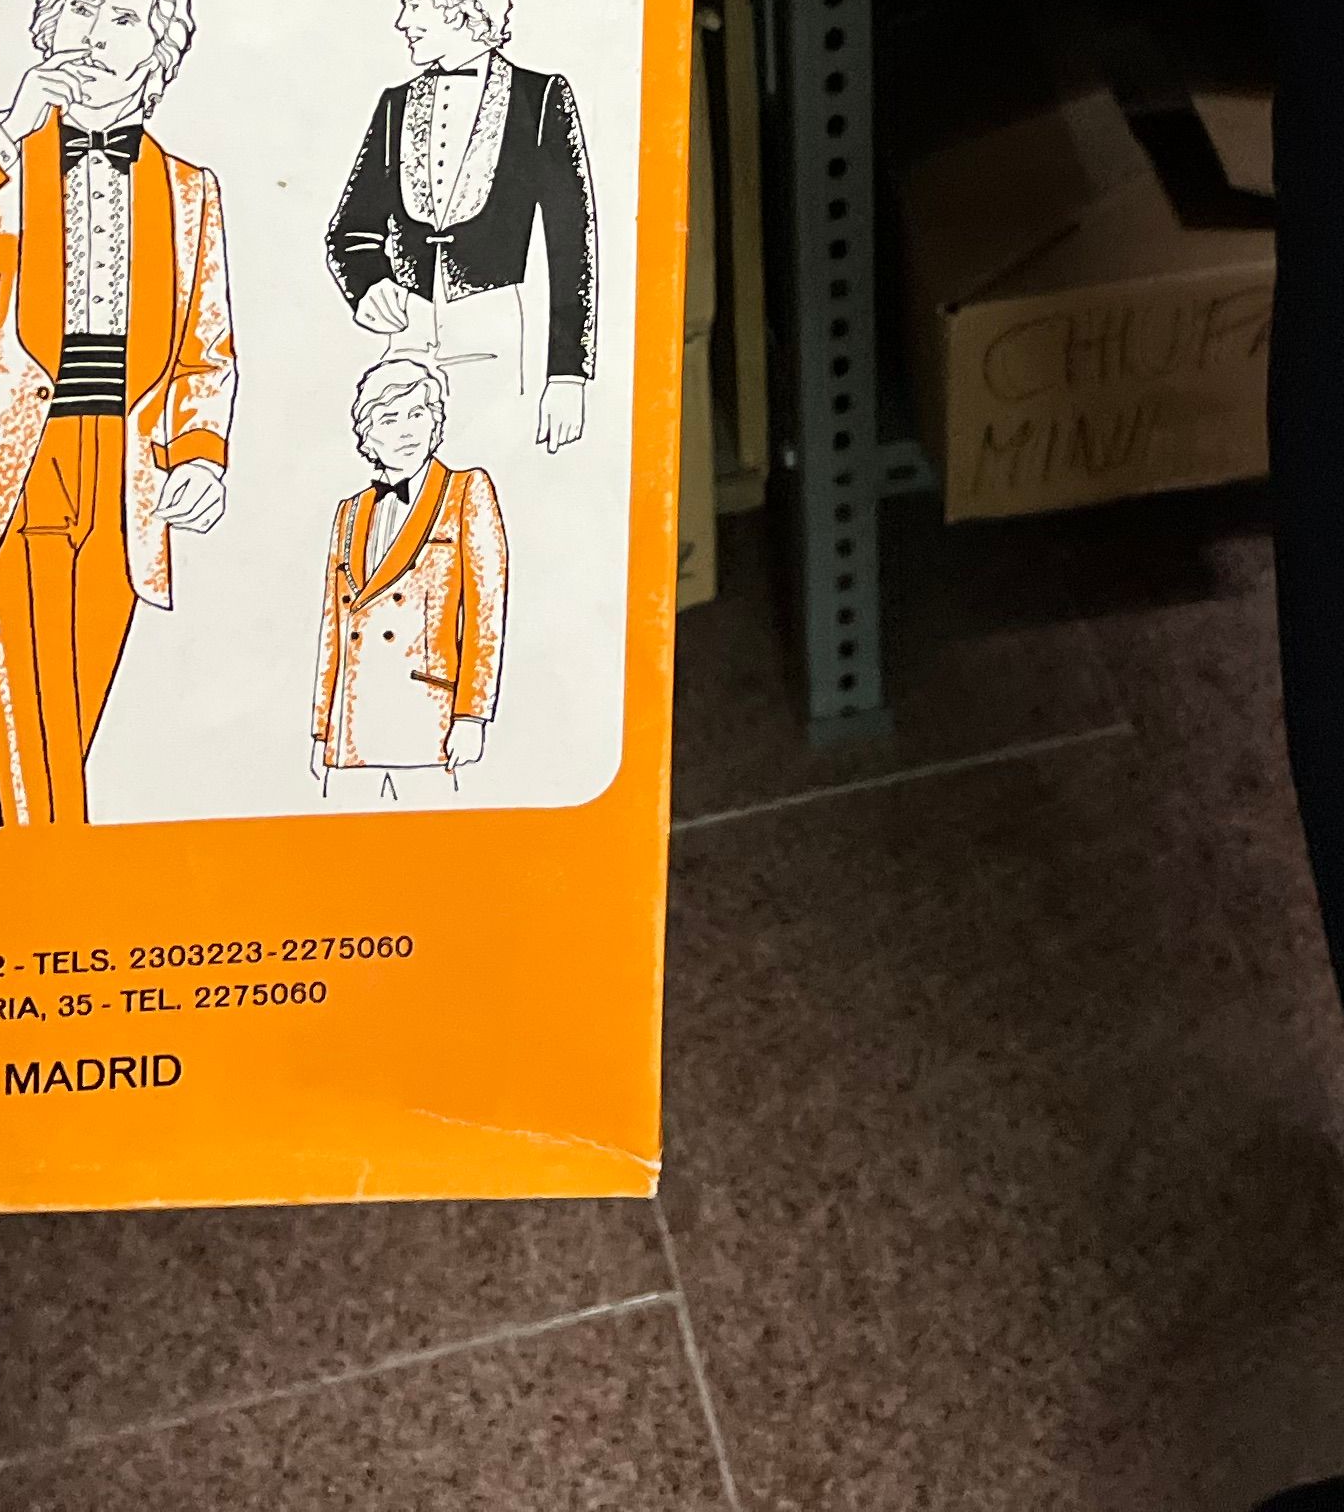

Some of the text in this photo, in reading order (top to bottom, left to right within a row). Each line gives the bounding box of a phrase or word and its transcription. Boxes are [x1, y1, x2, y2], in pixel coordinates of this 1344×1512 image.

[32, 949, 116, 975] TELS.
[58, 993, 93, 1018] 35
[119, 988, 182, 1013] TEL.
[194, 981, 327, 1009] 2275060
[4, 1054, 182, 1096] MADRID
